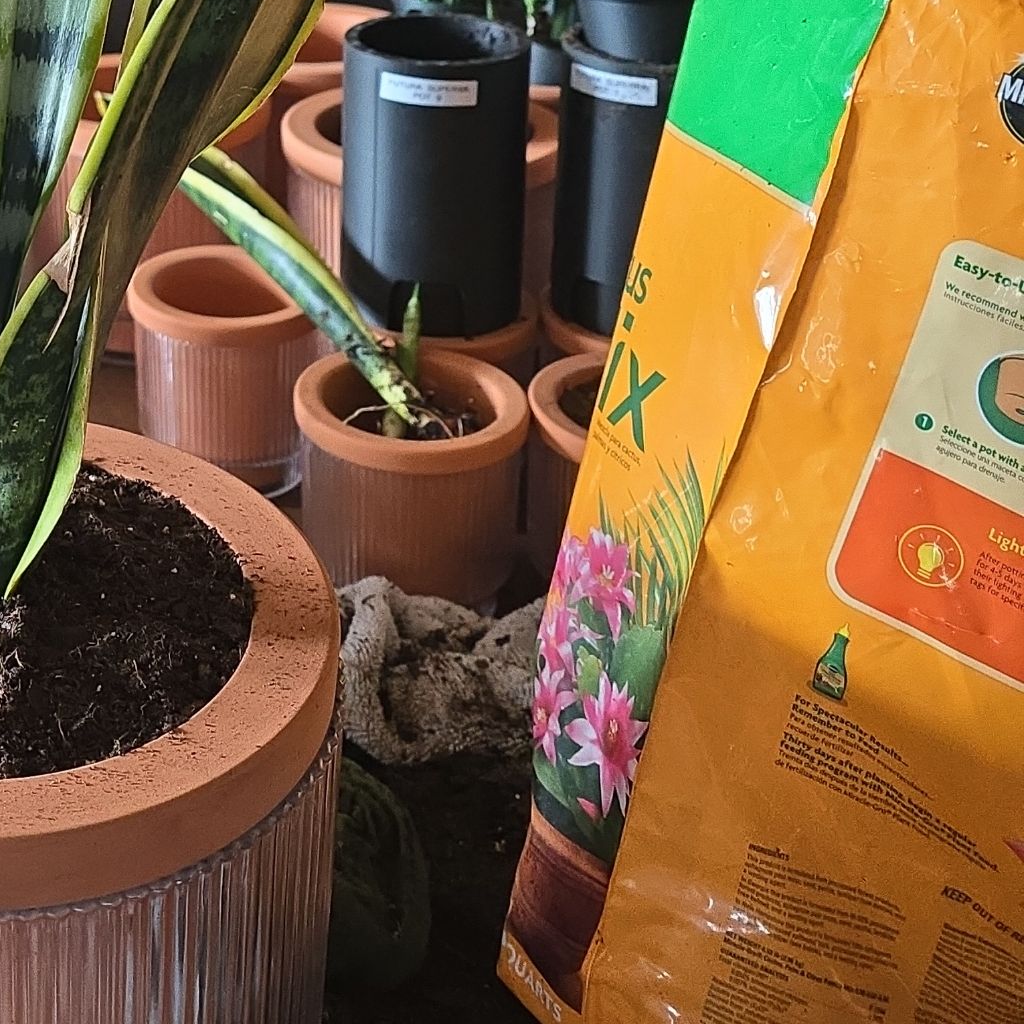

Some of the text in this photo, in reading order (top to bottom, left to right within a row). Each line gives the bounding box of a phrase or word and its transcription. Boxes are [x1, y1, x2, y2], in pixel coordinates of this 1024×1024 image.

[943, 291, 995, 319] Instrucciones
[945, 281, 1018, 318] We recommend
[936, 445, 961, 461] agujero
[962, 457, 977, 470] para
[940, 435, 976, 458] Seleccione
[977, 454, 990, 465] una
[991, 461, 1016, 478] maceta
[941, 425, 971, 445] Select
[979, 444, 997, 458] pot
[998, 453, 1019, 469] with
[973, 568, 992, 582] their
[976, 559, 989, 570] for
[1004, 574, 1022, 589] days
[979, 552, 1000, 565] After
[969, 577, 986, 590] tags
[987, 585, 1000, 597] for
[791, 703, 881, 754] Remember to Feed
[794, 693, 811, 707] For
[812, 703, 868, 736] Spectacular
[806, 722, 836, 739] obtener
[780, 739, 815, 763] feeding
[816, 759, 858, 782] program
[860, 779, 883, 794] with
[783, 731, 812, 750] Thirty
[814, 747, 836, 762] days
[837, 759, 863, 774] after
[941, 885, 972, 904] KEEP
[972, 902, 995, 922] OUT
[995, 921, 1010, 933] OF
